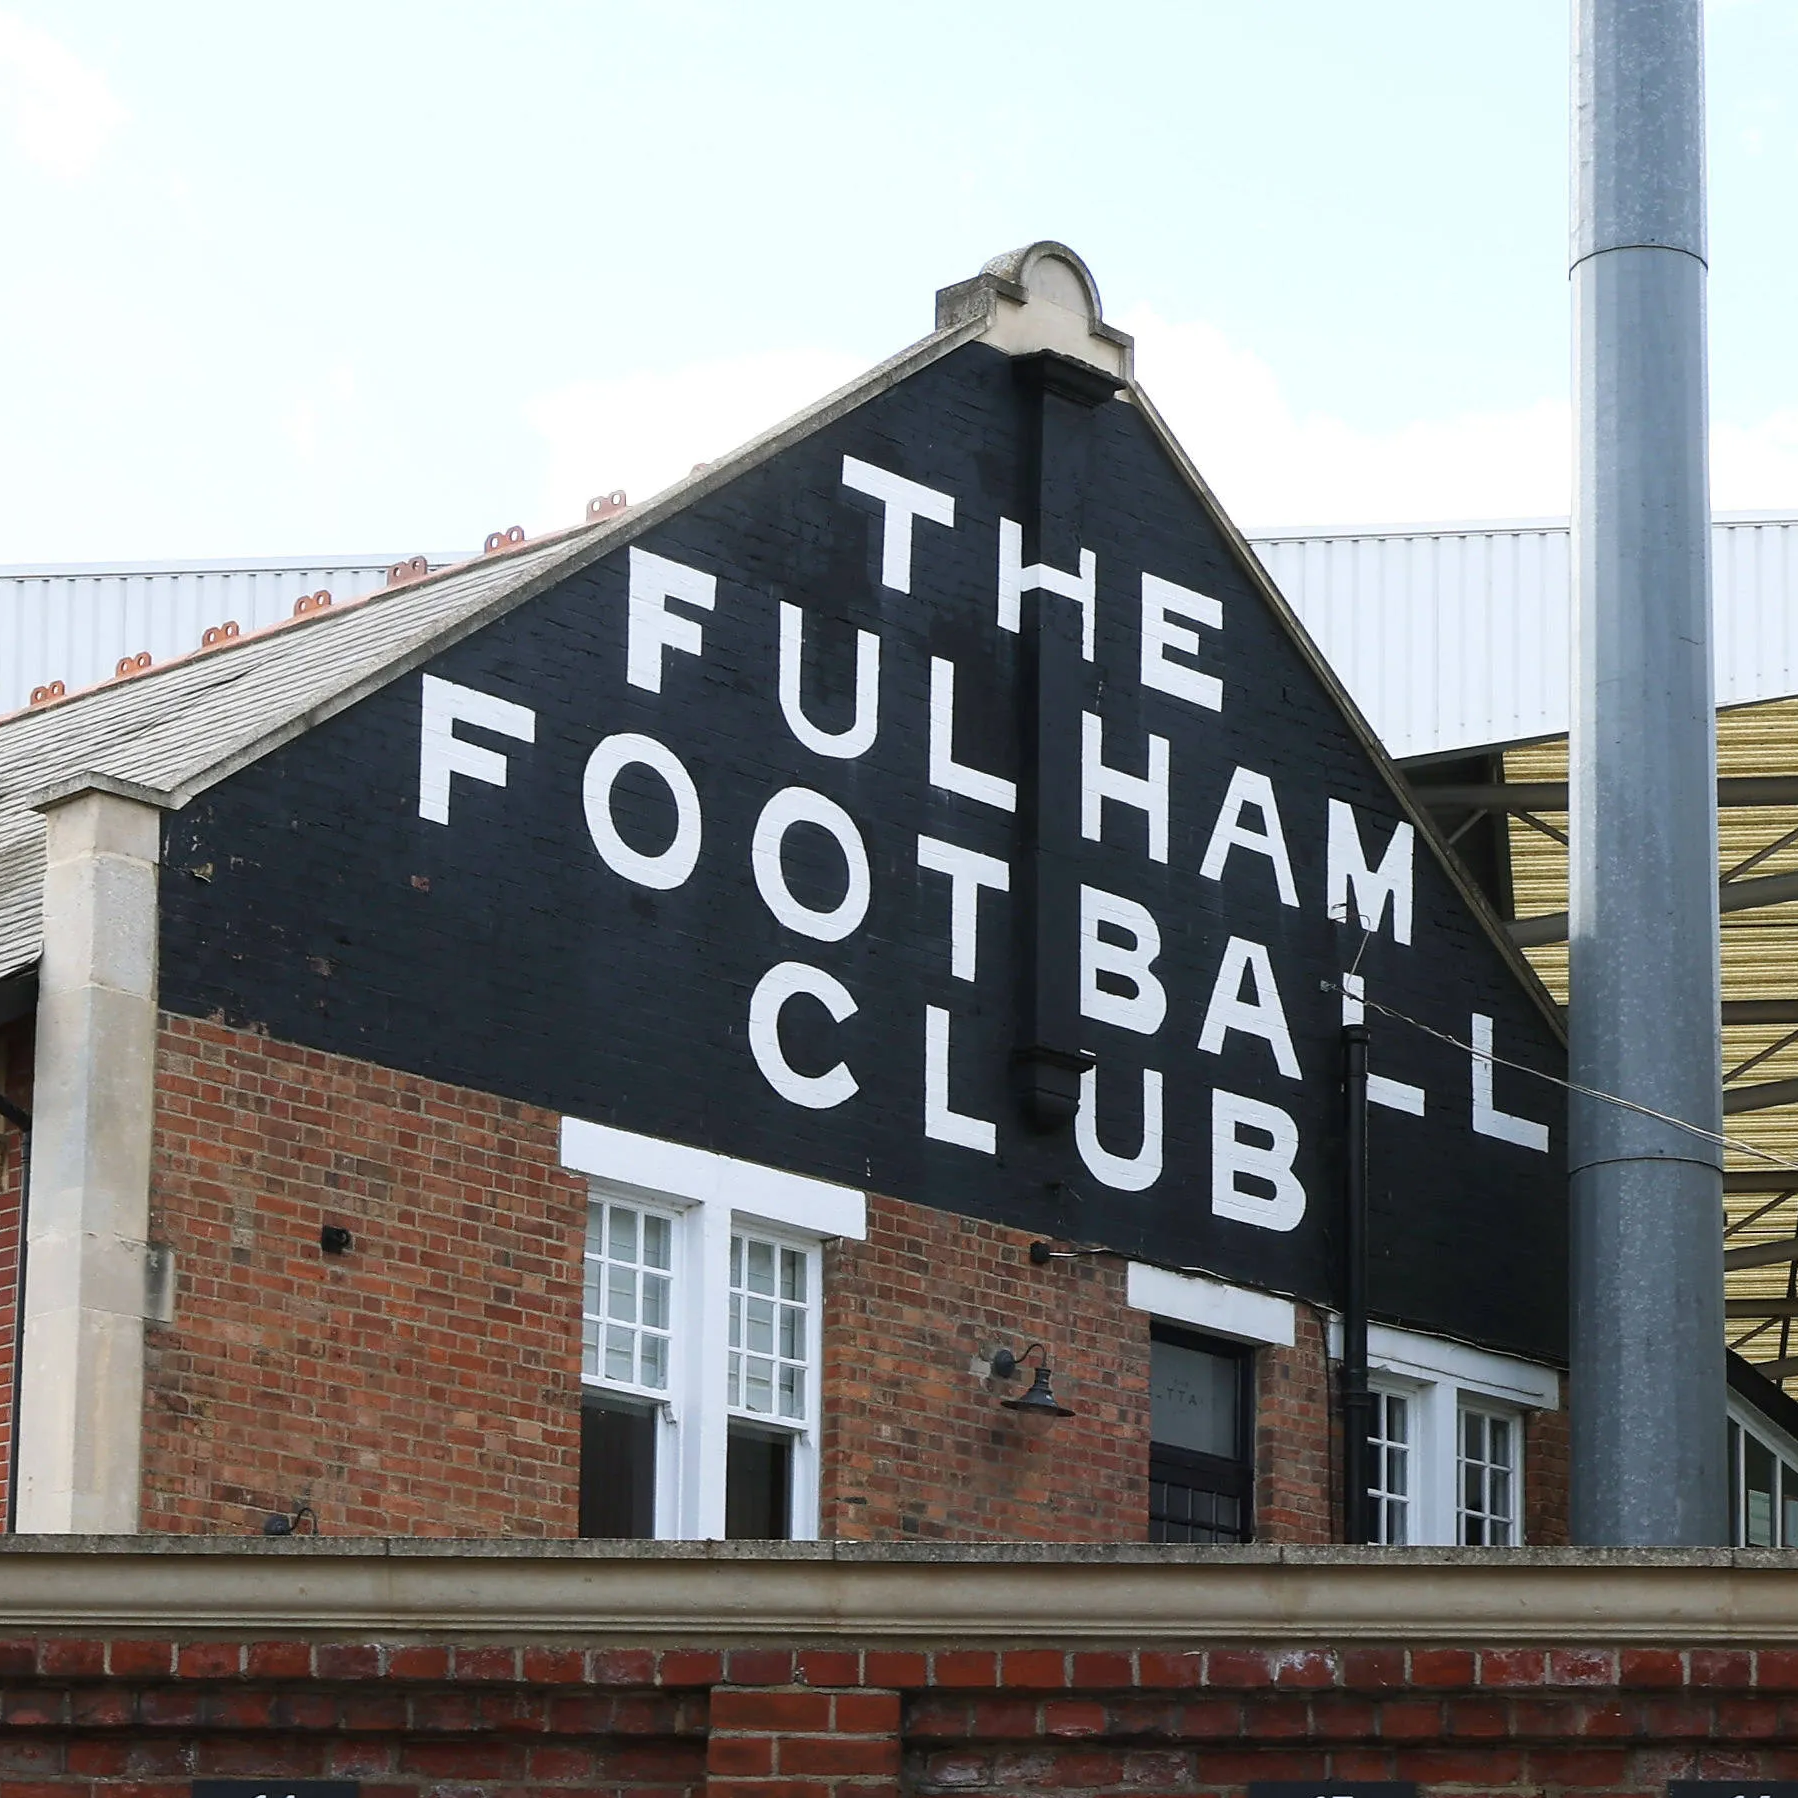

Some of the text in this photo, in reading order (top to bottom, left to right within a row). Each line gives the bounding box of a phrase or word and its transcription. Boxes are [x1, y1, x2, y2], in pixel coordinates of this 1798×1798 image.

[626, 544, 1415, 946] FULHAM
[842, 454, 1224, 713] THE
[418, 673, 1550, 1154] FOOTBALL
[749, 960, 1306, 1233] CLUB
